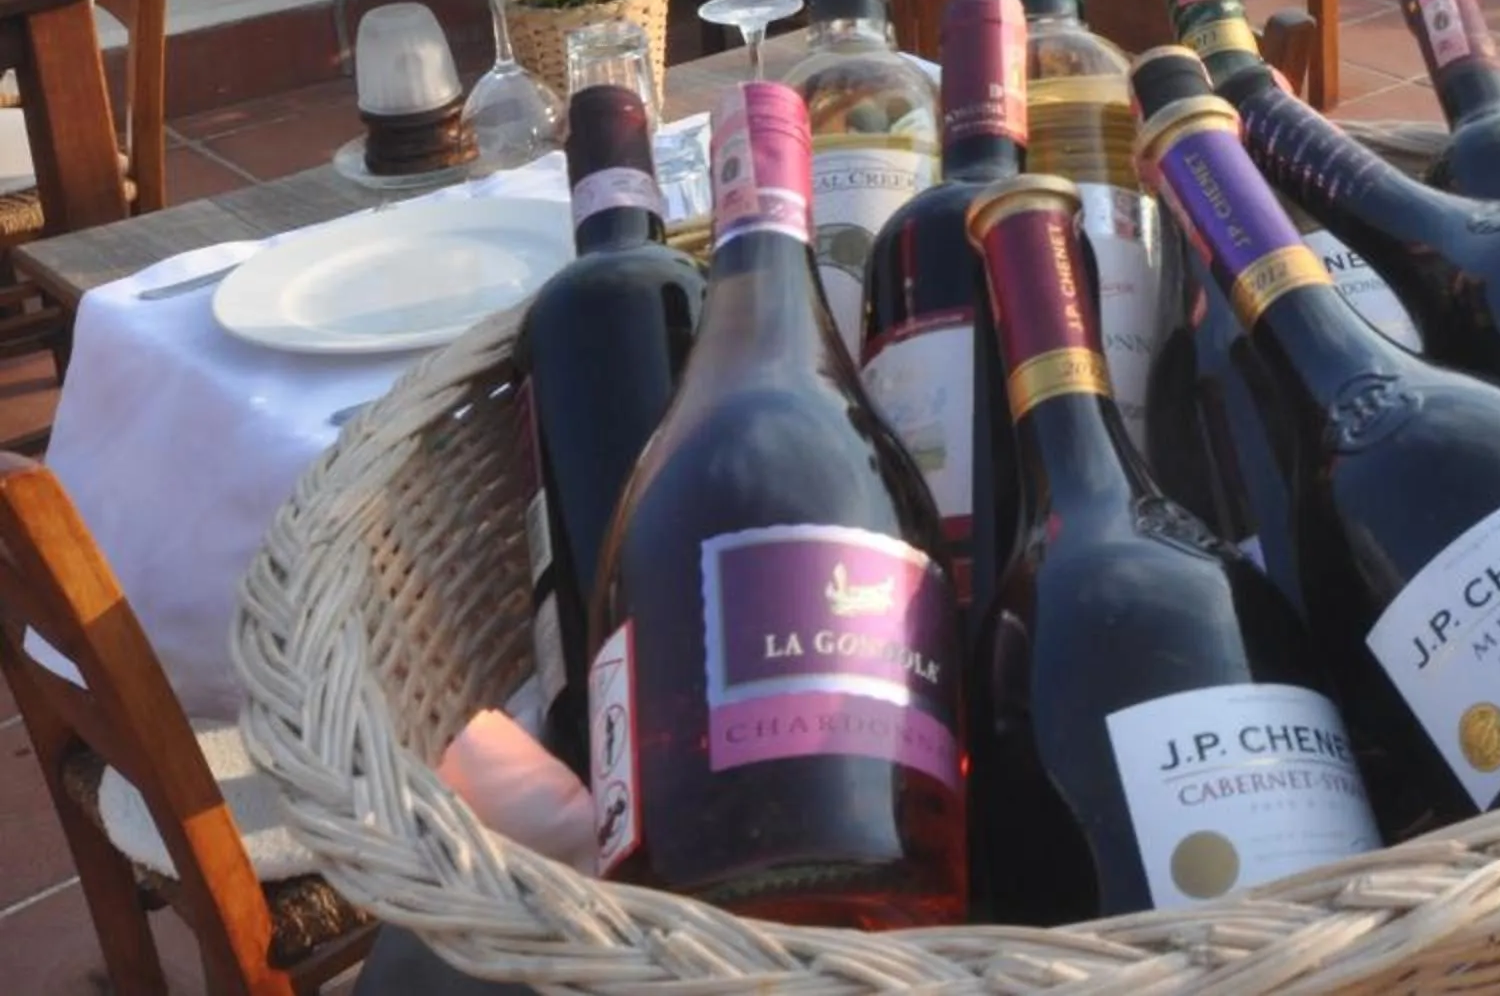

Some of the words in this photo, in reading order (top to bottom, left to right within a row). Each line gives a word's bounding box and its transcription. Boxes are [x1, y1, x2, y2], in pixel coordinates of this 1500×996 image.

[765, 632, 804, 659] LA
[1413, 608, 1461, 670] J.P.
[1160, 731, 1228, 772] J.P.
[1238, 724, 1353, 762] CHENE
